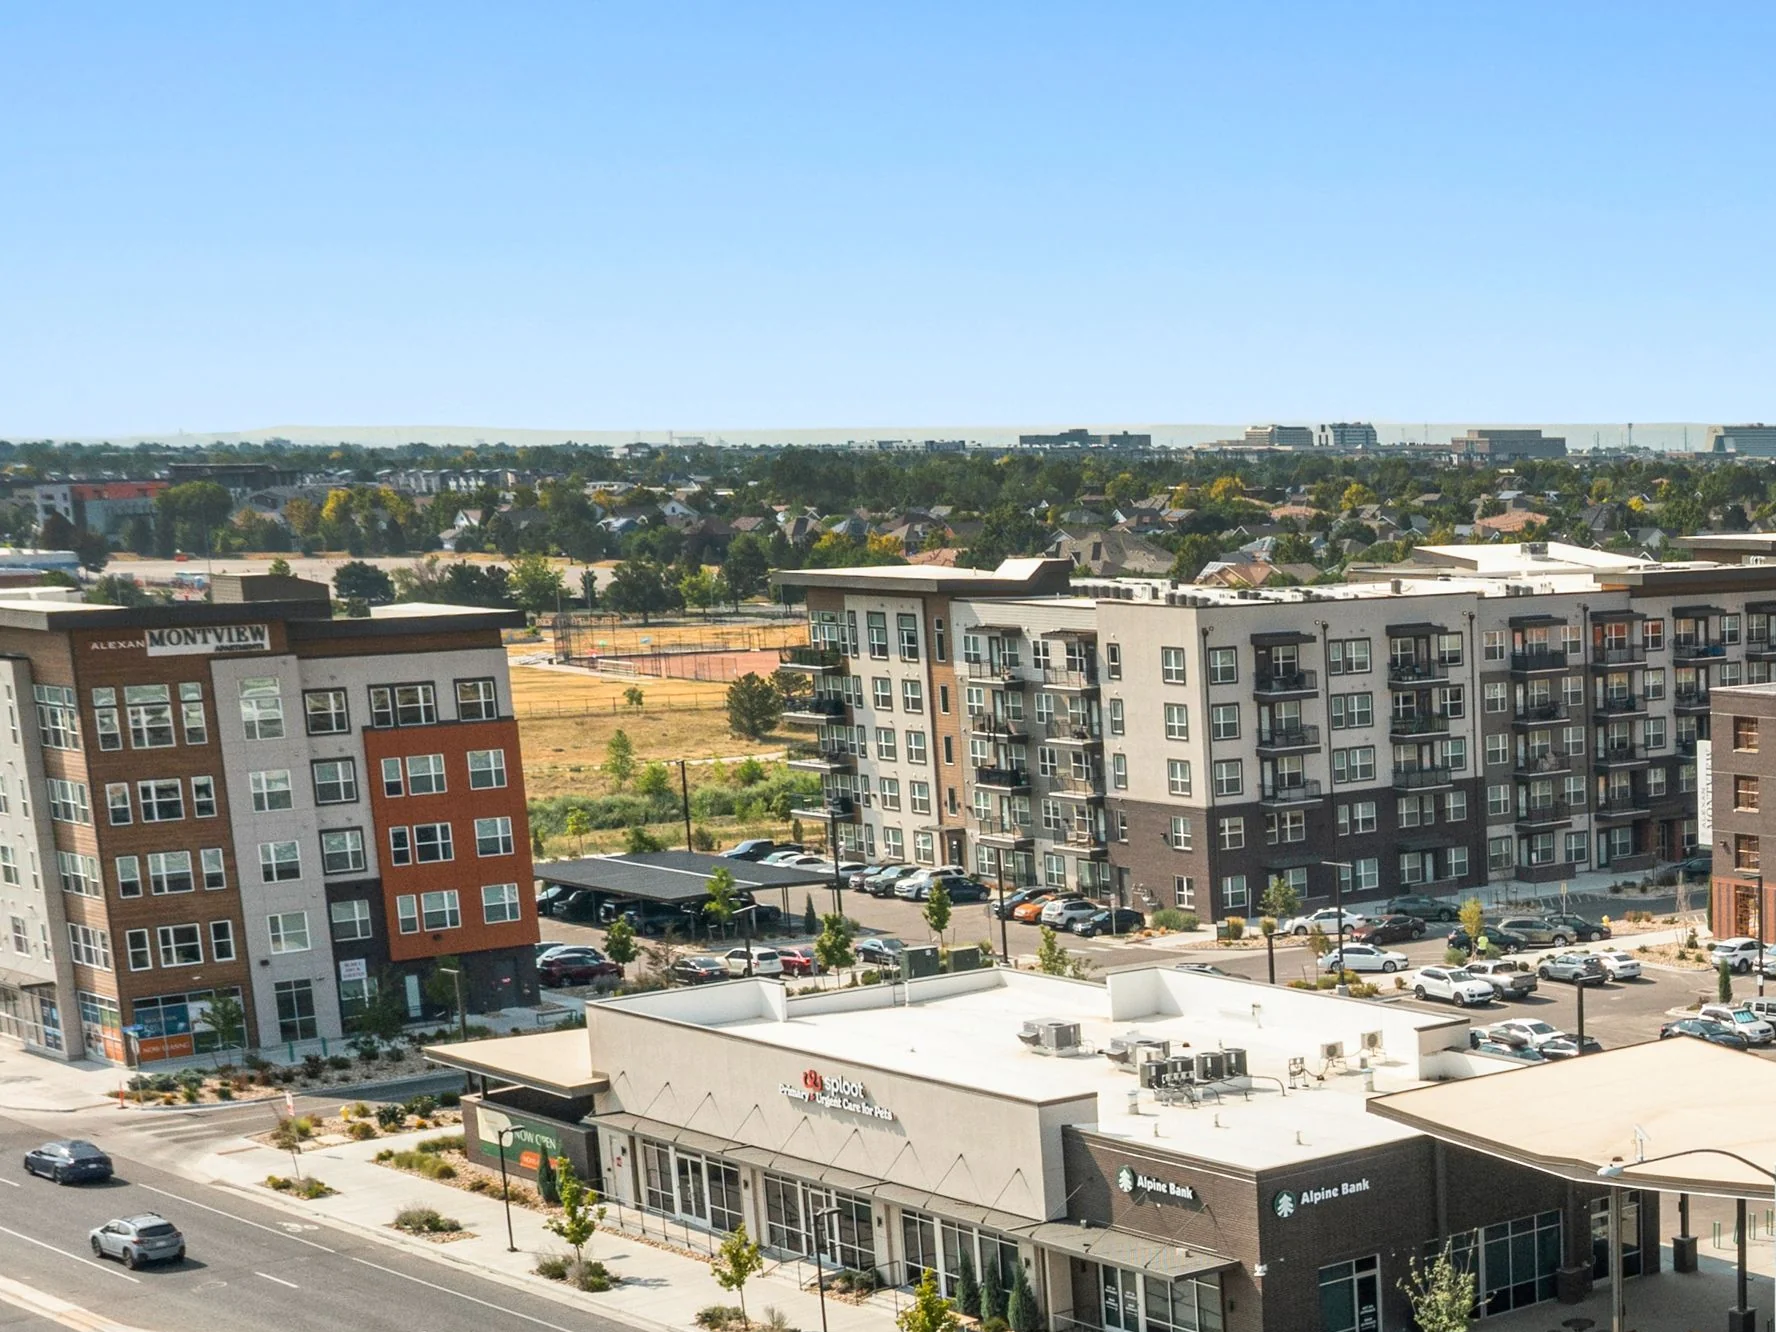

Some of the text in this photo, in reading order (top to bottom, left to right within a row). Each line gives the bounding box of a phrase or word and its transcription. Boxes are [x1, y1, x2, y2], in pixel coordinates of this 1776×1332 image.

[91, 639, 145, 650] ALEXAN
[148, 625, 267, 647] MONTVIEW
[824, 1075, 865, 1098] sploot
[779, 1084, 893, 1120] Primary Urgent Care for Pets
[1137, 1175, 1193, 1199] Alpine Bank
[1301, 1178, 1370, 1204] Alpine Bank
